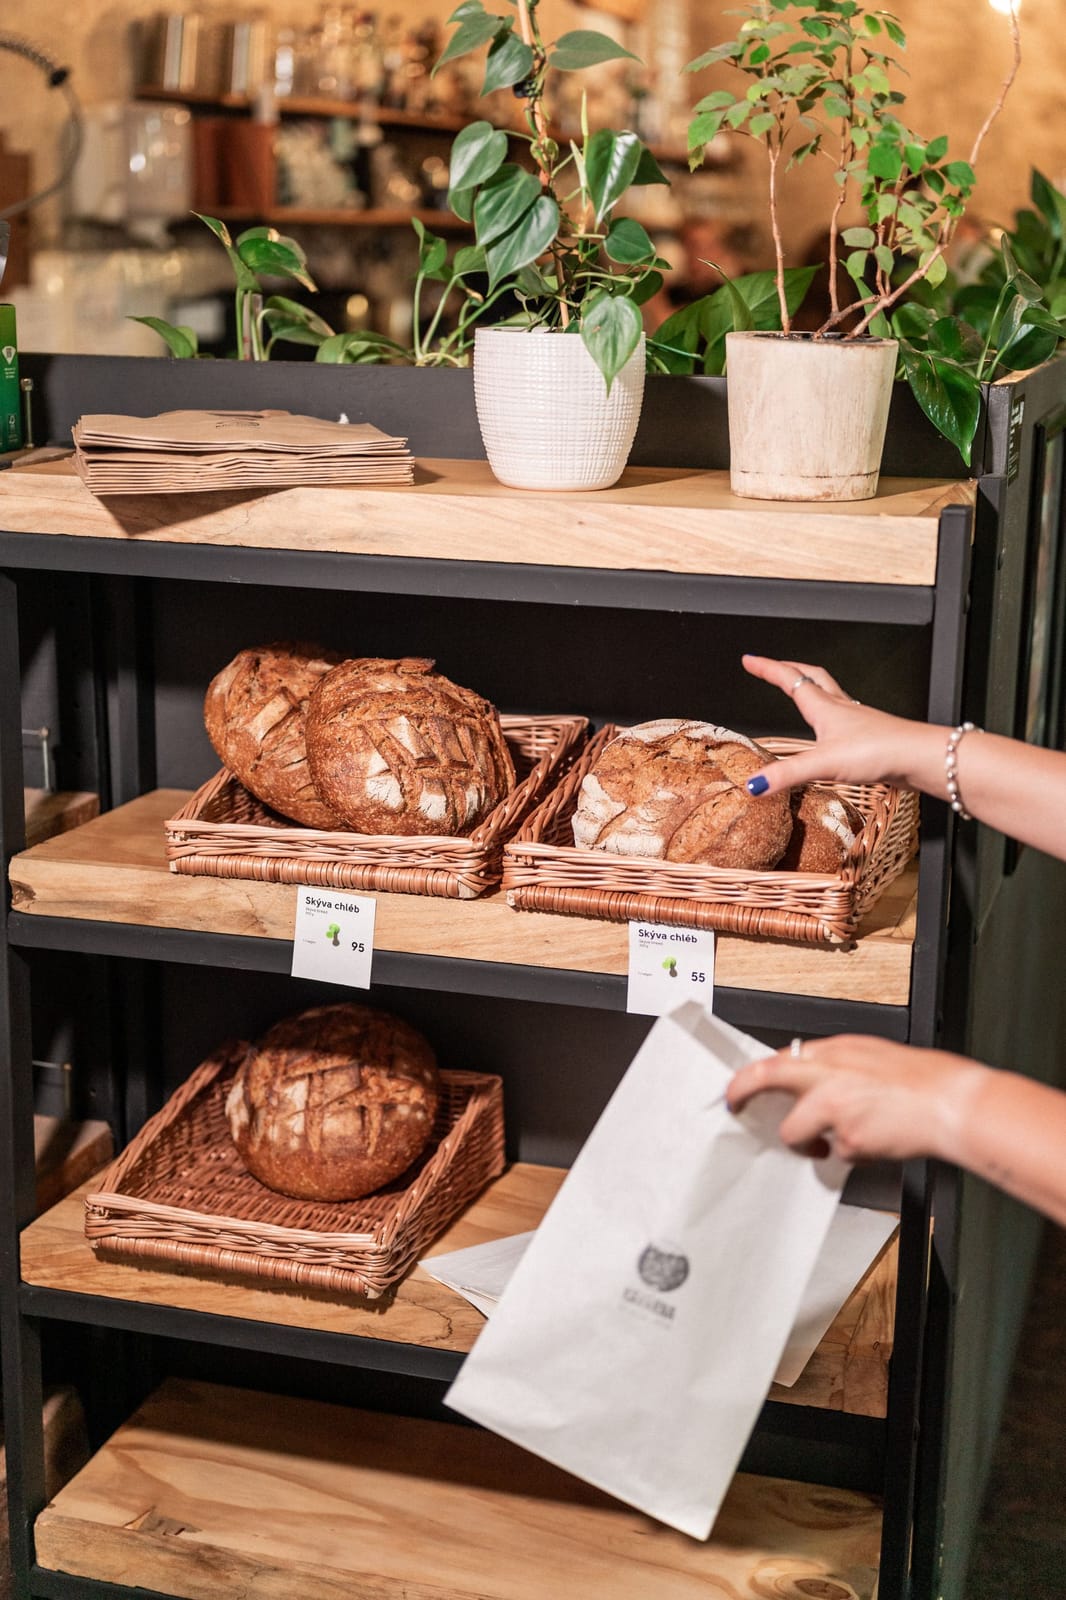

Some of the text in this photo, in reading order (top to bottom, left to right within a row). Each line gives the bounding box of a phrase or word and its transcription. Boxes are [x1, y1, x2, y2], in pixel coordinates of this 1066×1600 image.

[305, 896, 332, 908] Skýva
[335, 902, 360, 913] chléb
[638, 930, 667, 940] Skýva
[670, 934, 698, 943] chléb
[351, 941, 365, 952] 95
[691, 972, 706, 983] 55
